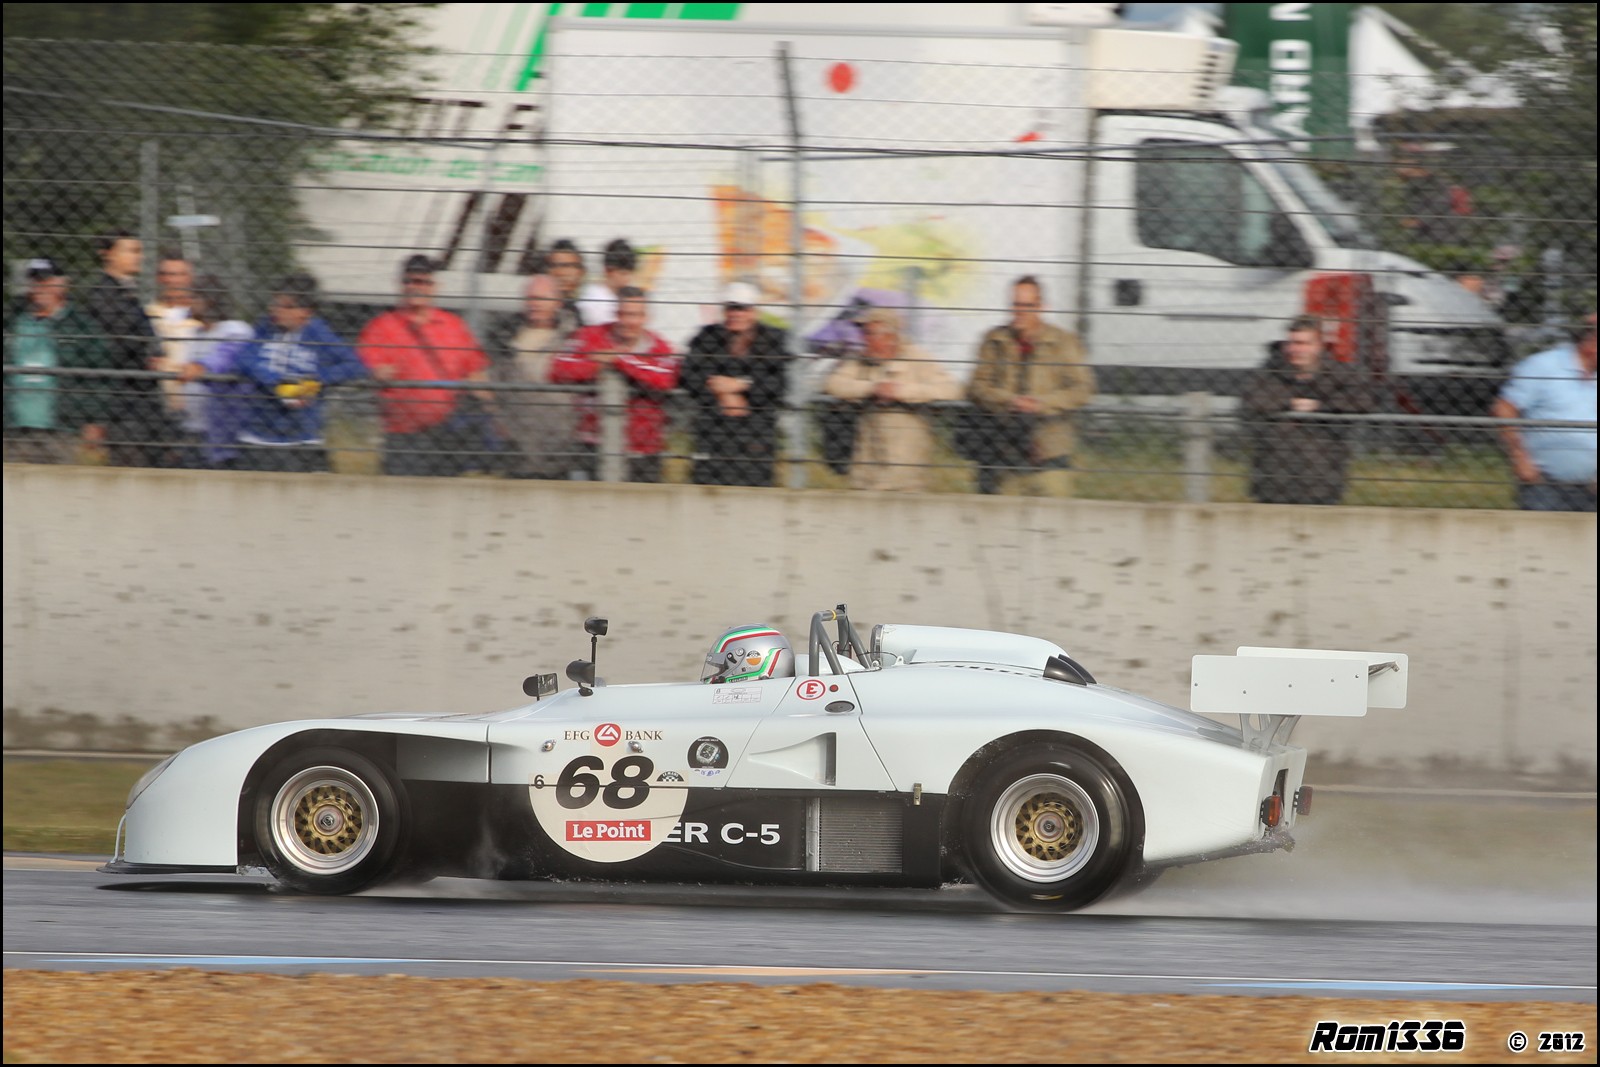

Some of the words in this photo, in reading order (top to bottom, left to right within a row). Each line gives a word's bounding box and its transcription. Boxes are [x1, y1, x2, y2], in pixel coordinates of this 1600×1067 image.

[805, 682, 819, 695] E
[564, 730, 590, 741] EFG
[625, 730, 663, 741] BANK
[534, 774, 545, 790] 6
[555, 755, 654, 810] 68
[572, 823, 594, 839] Le
[596, 822, 645, 839] Point
[720, 822, 781, 845] C-5
